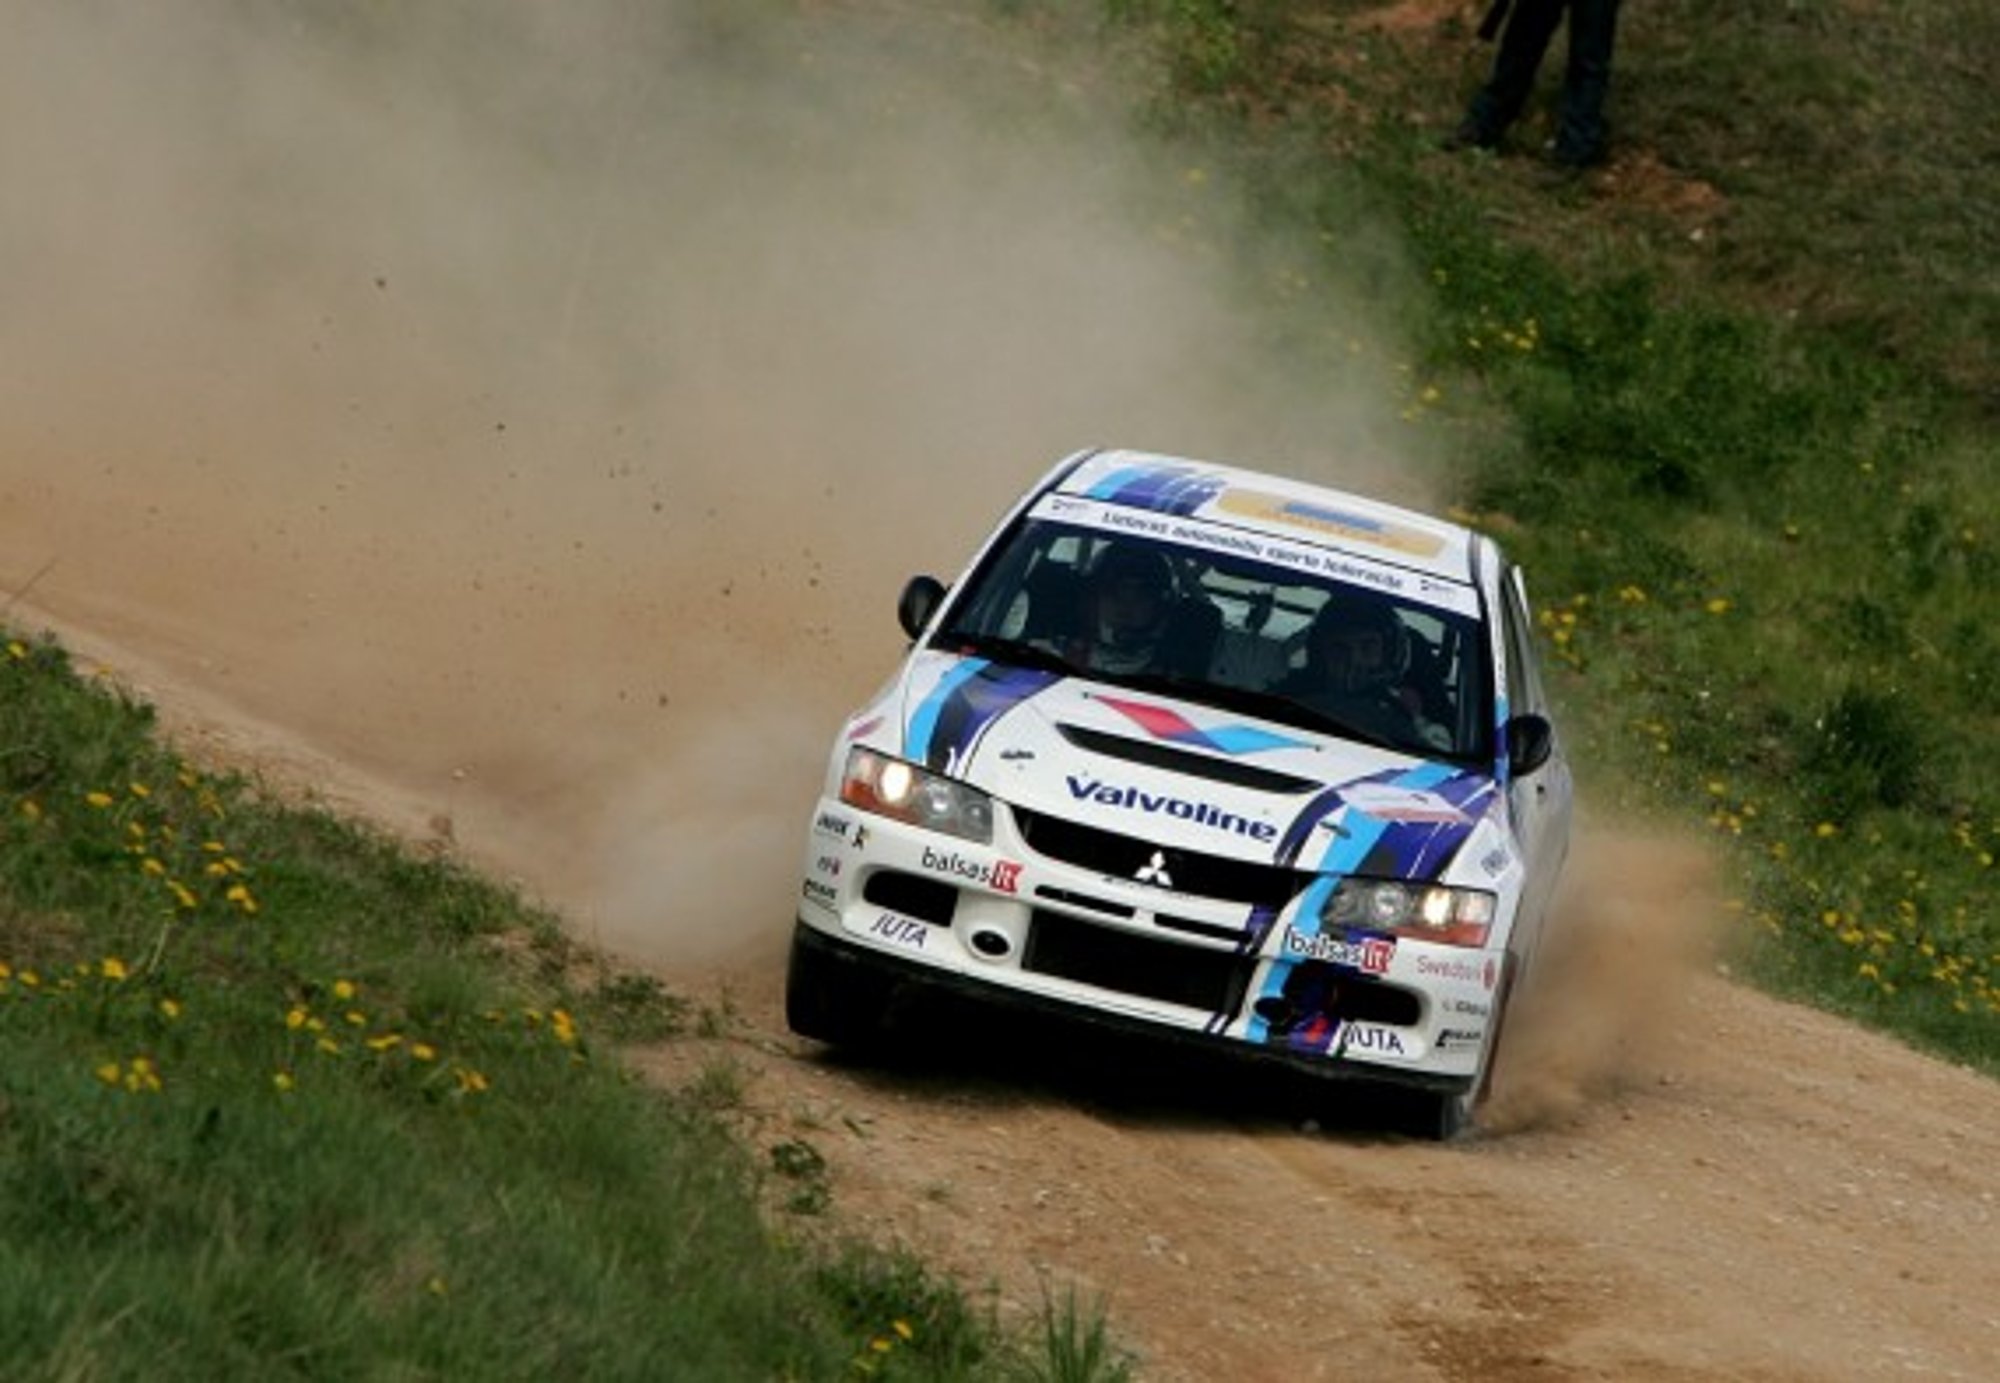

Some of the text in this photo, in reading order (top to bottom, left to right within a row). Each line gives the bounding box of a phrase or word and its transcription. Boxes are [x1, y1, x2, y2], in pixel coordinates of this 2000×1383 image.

[1066, 775, 1278, 843] Valvoline
[922, 846, 990, 882] balsas
[1290, 932, 1361, 963] balsas
